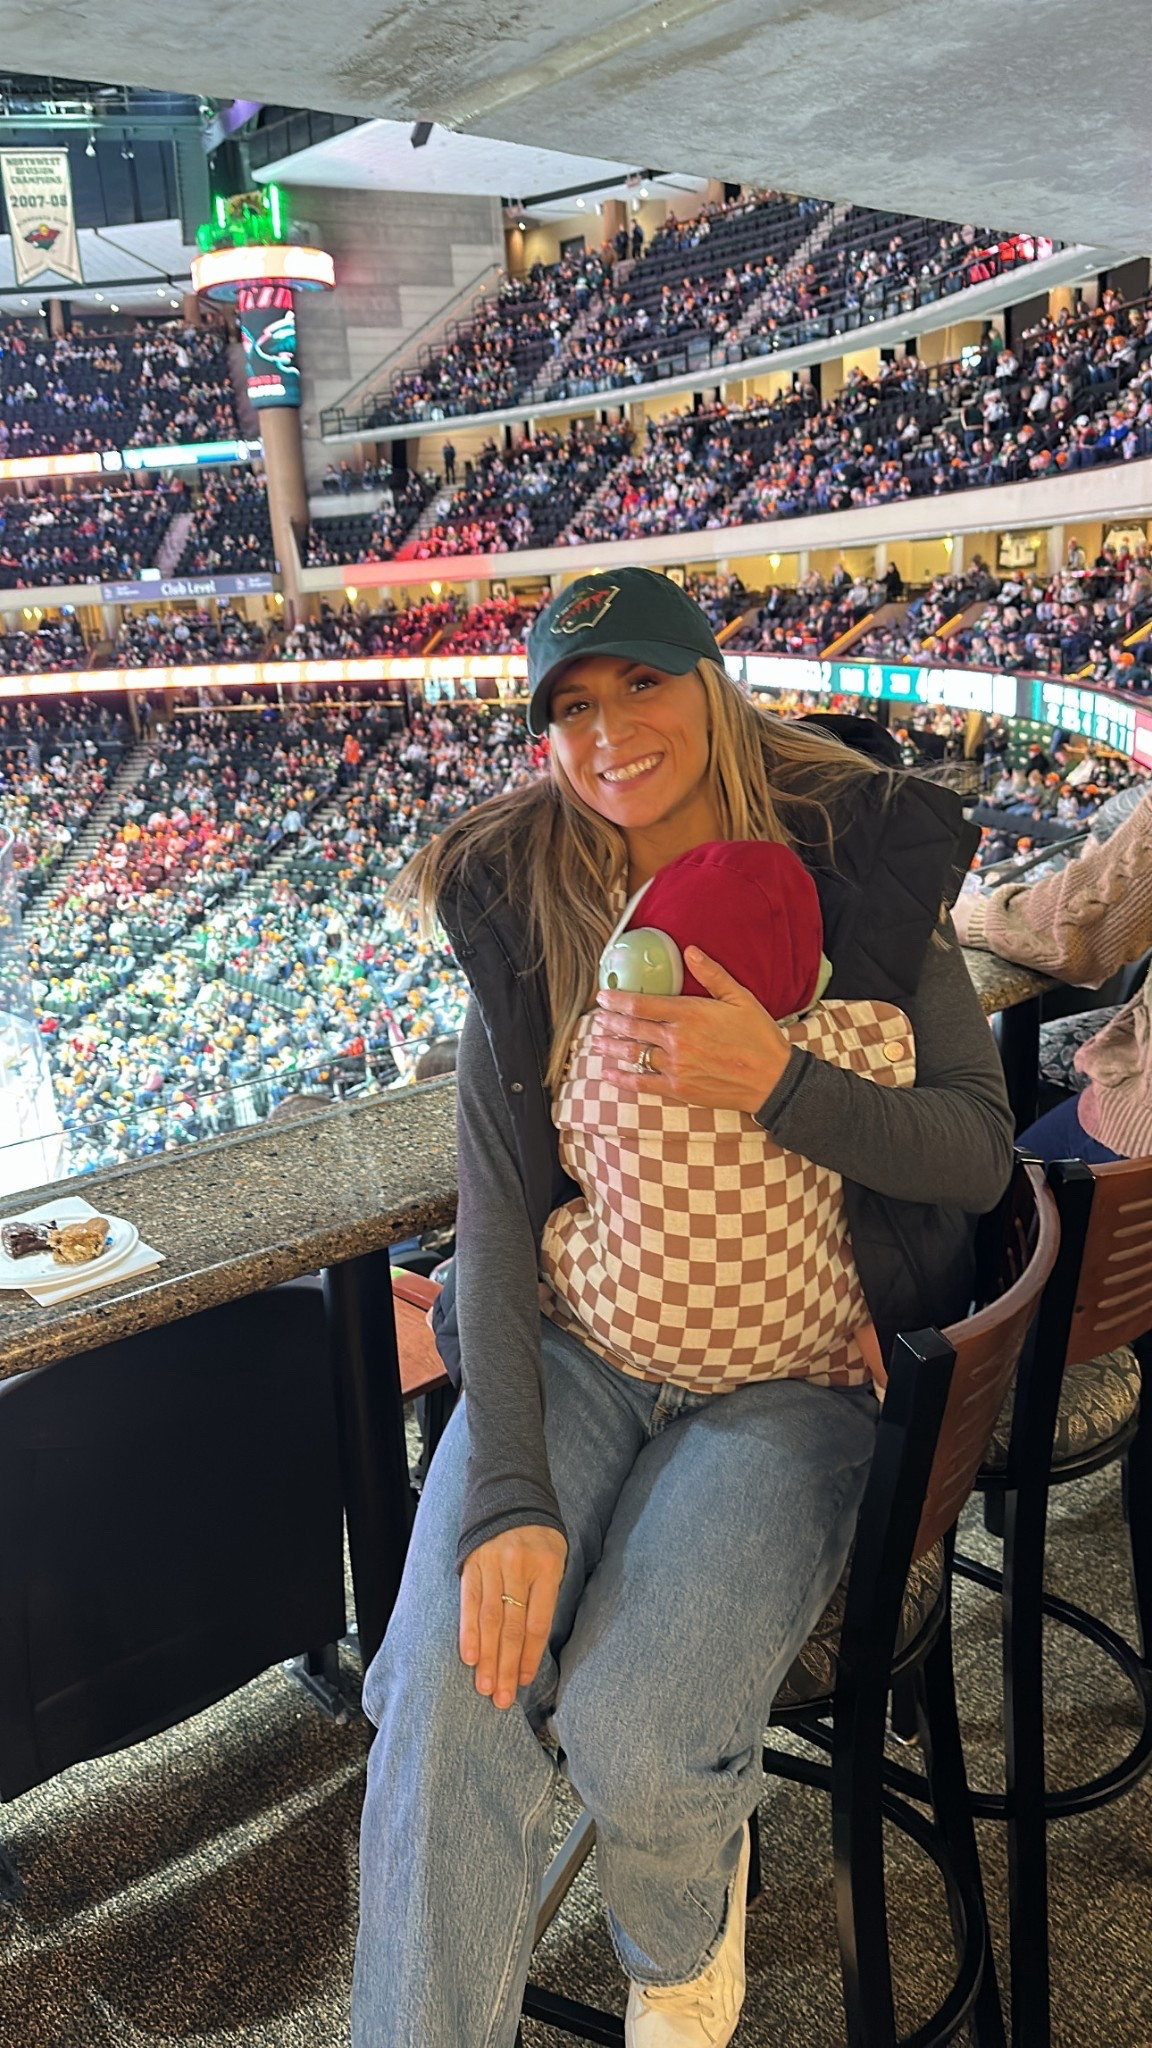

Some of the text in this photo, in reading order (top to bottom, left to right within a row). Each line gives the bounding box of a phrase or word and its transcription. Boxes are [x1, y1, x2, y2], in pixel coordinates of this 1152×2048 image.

[10, 195, 67, 207] 2007-08
[161, 579, 216, 596] Club Level
